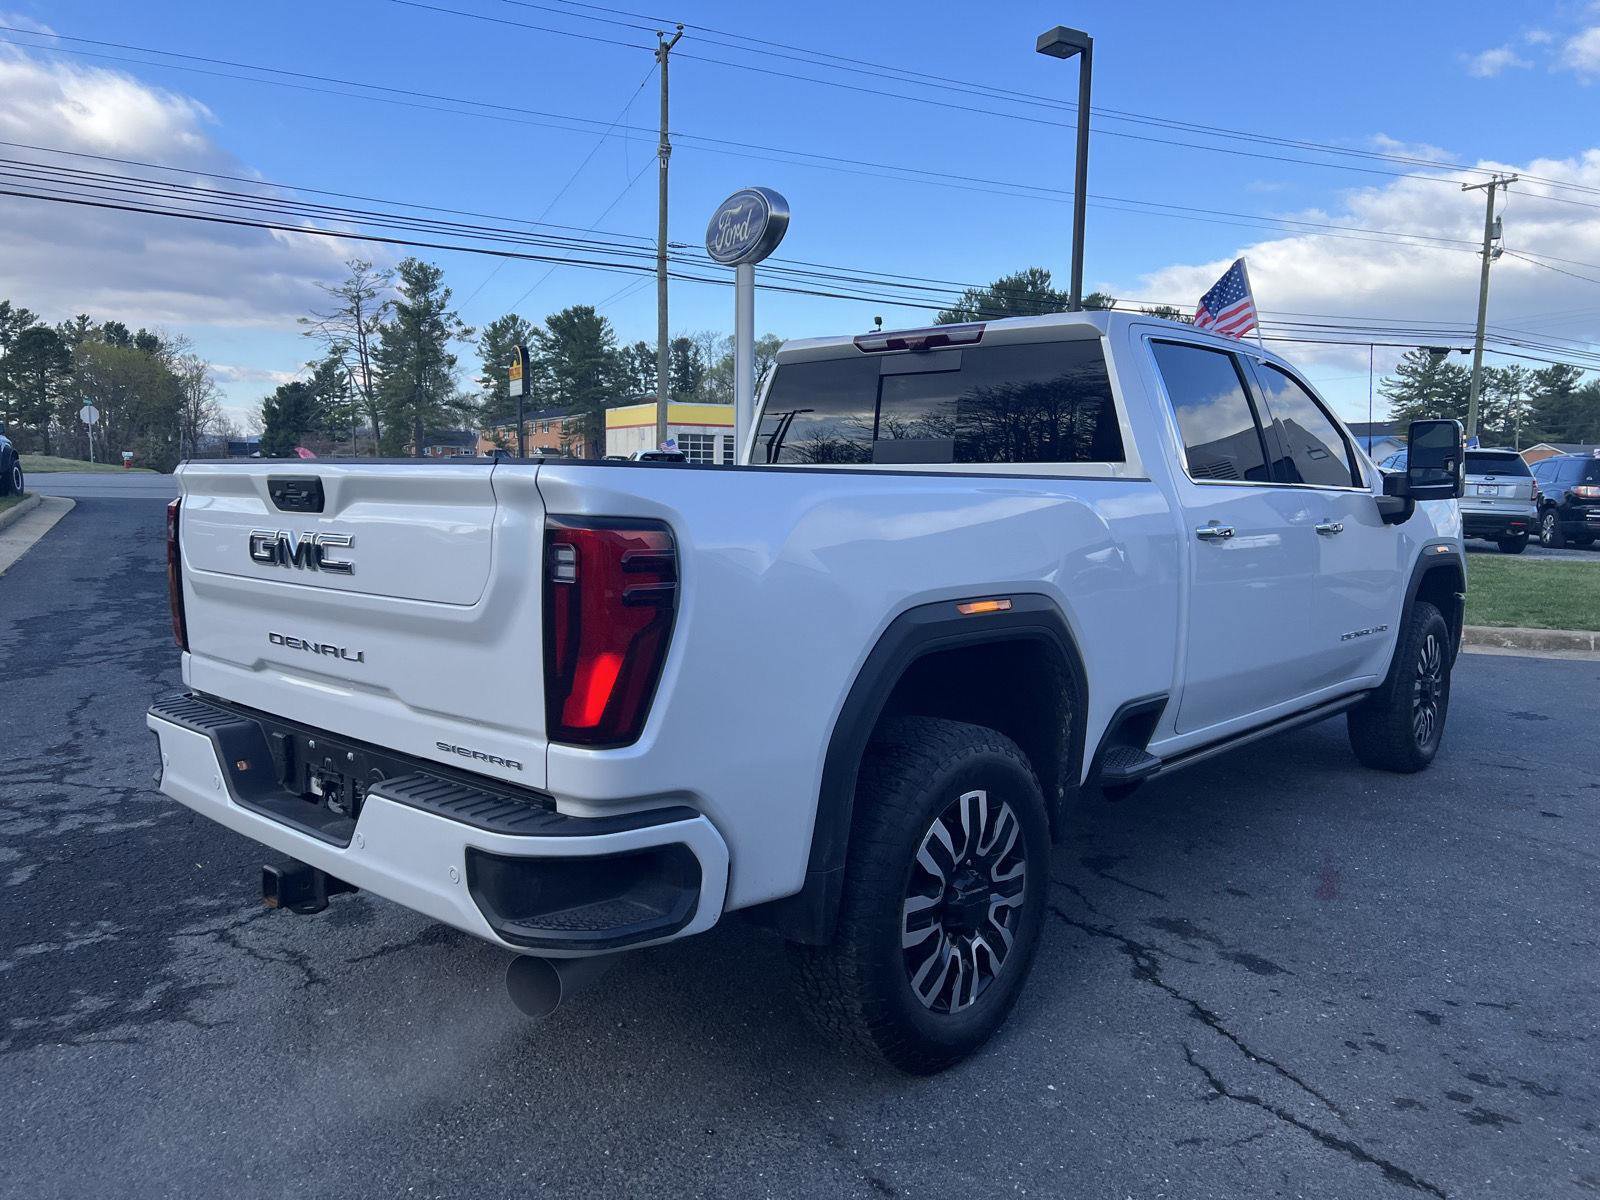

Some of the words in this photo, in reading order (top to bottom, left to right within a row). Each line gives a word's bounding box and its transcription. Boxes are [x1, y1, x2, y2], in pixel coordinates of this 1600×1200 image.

[715, 204, 752, 252] Ford
[249, 528, 355, 576] GMC
[269, 632, 364, 663] DENALI
[436, 741, 523, 771] SIERRA
